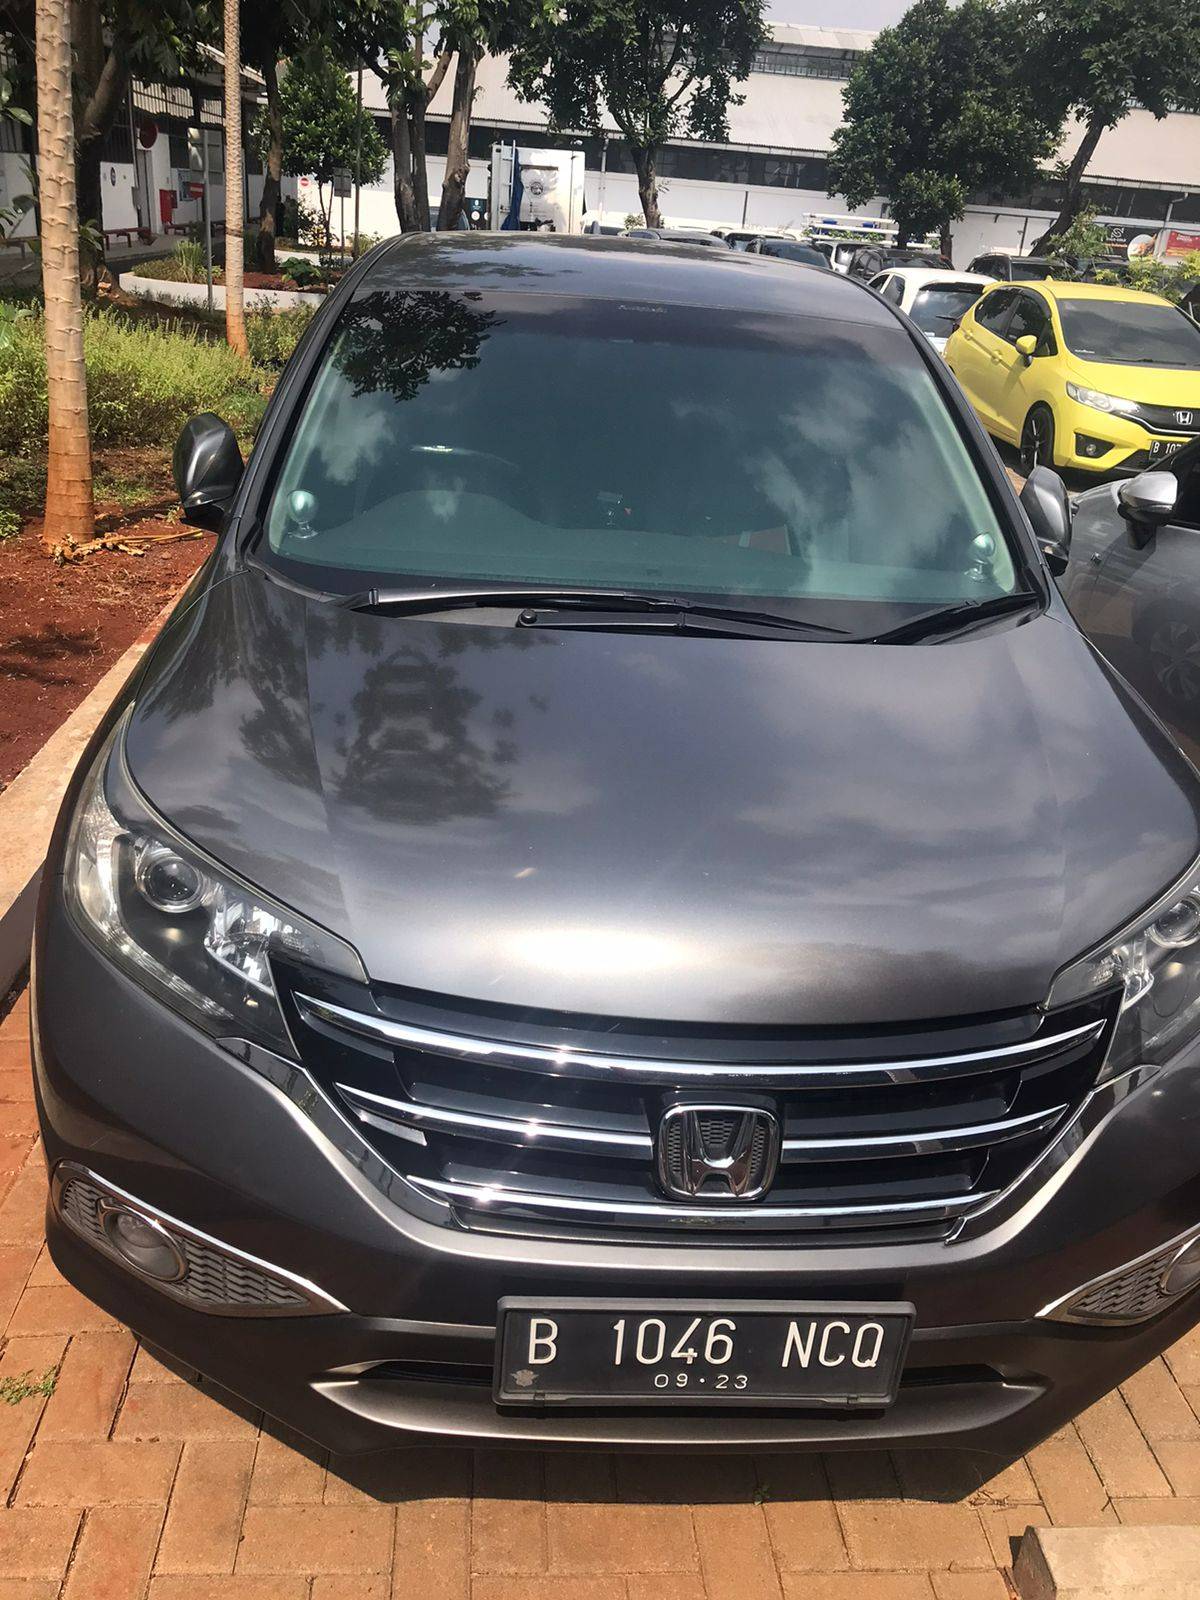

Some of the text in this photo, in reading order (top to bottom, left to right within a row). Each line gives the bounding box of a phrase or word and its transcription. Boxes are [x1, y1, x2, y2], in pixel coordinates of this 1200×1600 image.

[1153, 442, 1182, 454] B 10
[528, 1317, 885, 1368] B 1046 NCQ
